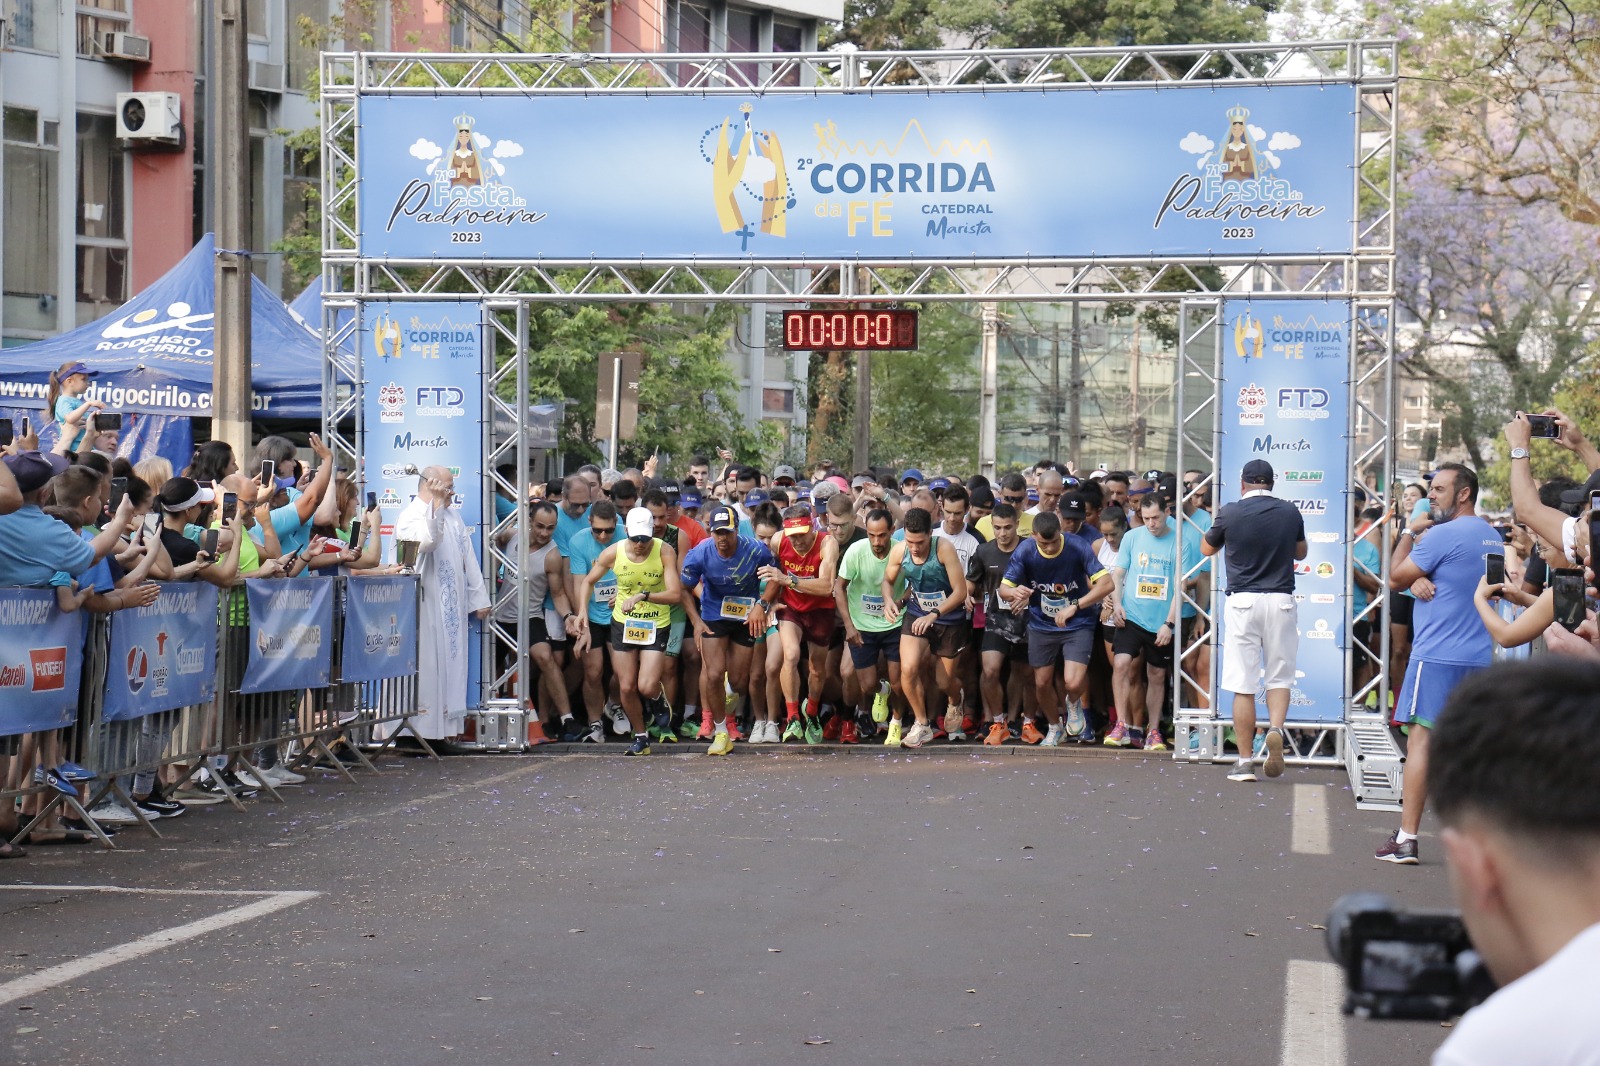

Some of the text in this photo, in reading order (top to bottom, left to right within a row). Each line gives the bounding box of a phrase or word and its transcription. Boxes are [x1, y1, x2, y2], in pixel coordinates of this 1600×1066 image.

[810, 162, 995, 194] CORRIDA
[435, 181, 527, 207] Festa da
[1204, 175, 1303, 202] Festa da
[385, 179, 548, 232] Padroeira
[1154, 173, 1325, 229] Padroeira
[815, 192, 894, 237] da FÉ
[921, 204, 993, 215] CATEDRAL
[925, 216, 993, 239] Marista
[1222, 227, 1255, 239] 2023
[450, 232, 482, 244] 2023
[95, 335, 202, 351] RODRIGO
[409, 331, 475, 343] CORRIDA
[1271, 331, 1342, 342] CORRIDA
[137, 343, 214, 357] CIRILO
[422, 342, 440, 359] FÉ
[1285, 341, 1304, 359] FÉ
[416, 406, 465, 418] educação
[1277, 408, 1329, 421] educação
[393, 431, 448, 451] Marista
[1252, 434, 1311, 454] Marista
[599, 587, 616, 596] 442
[1141, 585, 1158, 594] 882
[726, 604, 744, 614] 987
[922, 600, 939, 608] 406
[643, 610, 659, 619] RUN
[628, 630, 645, 639] 941
